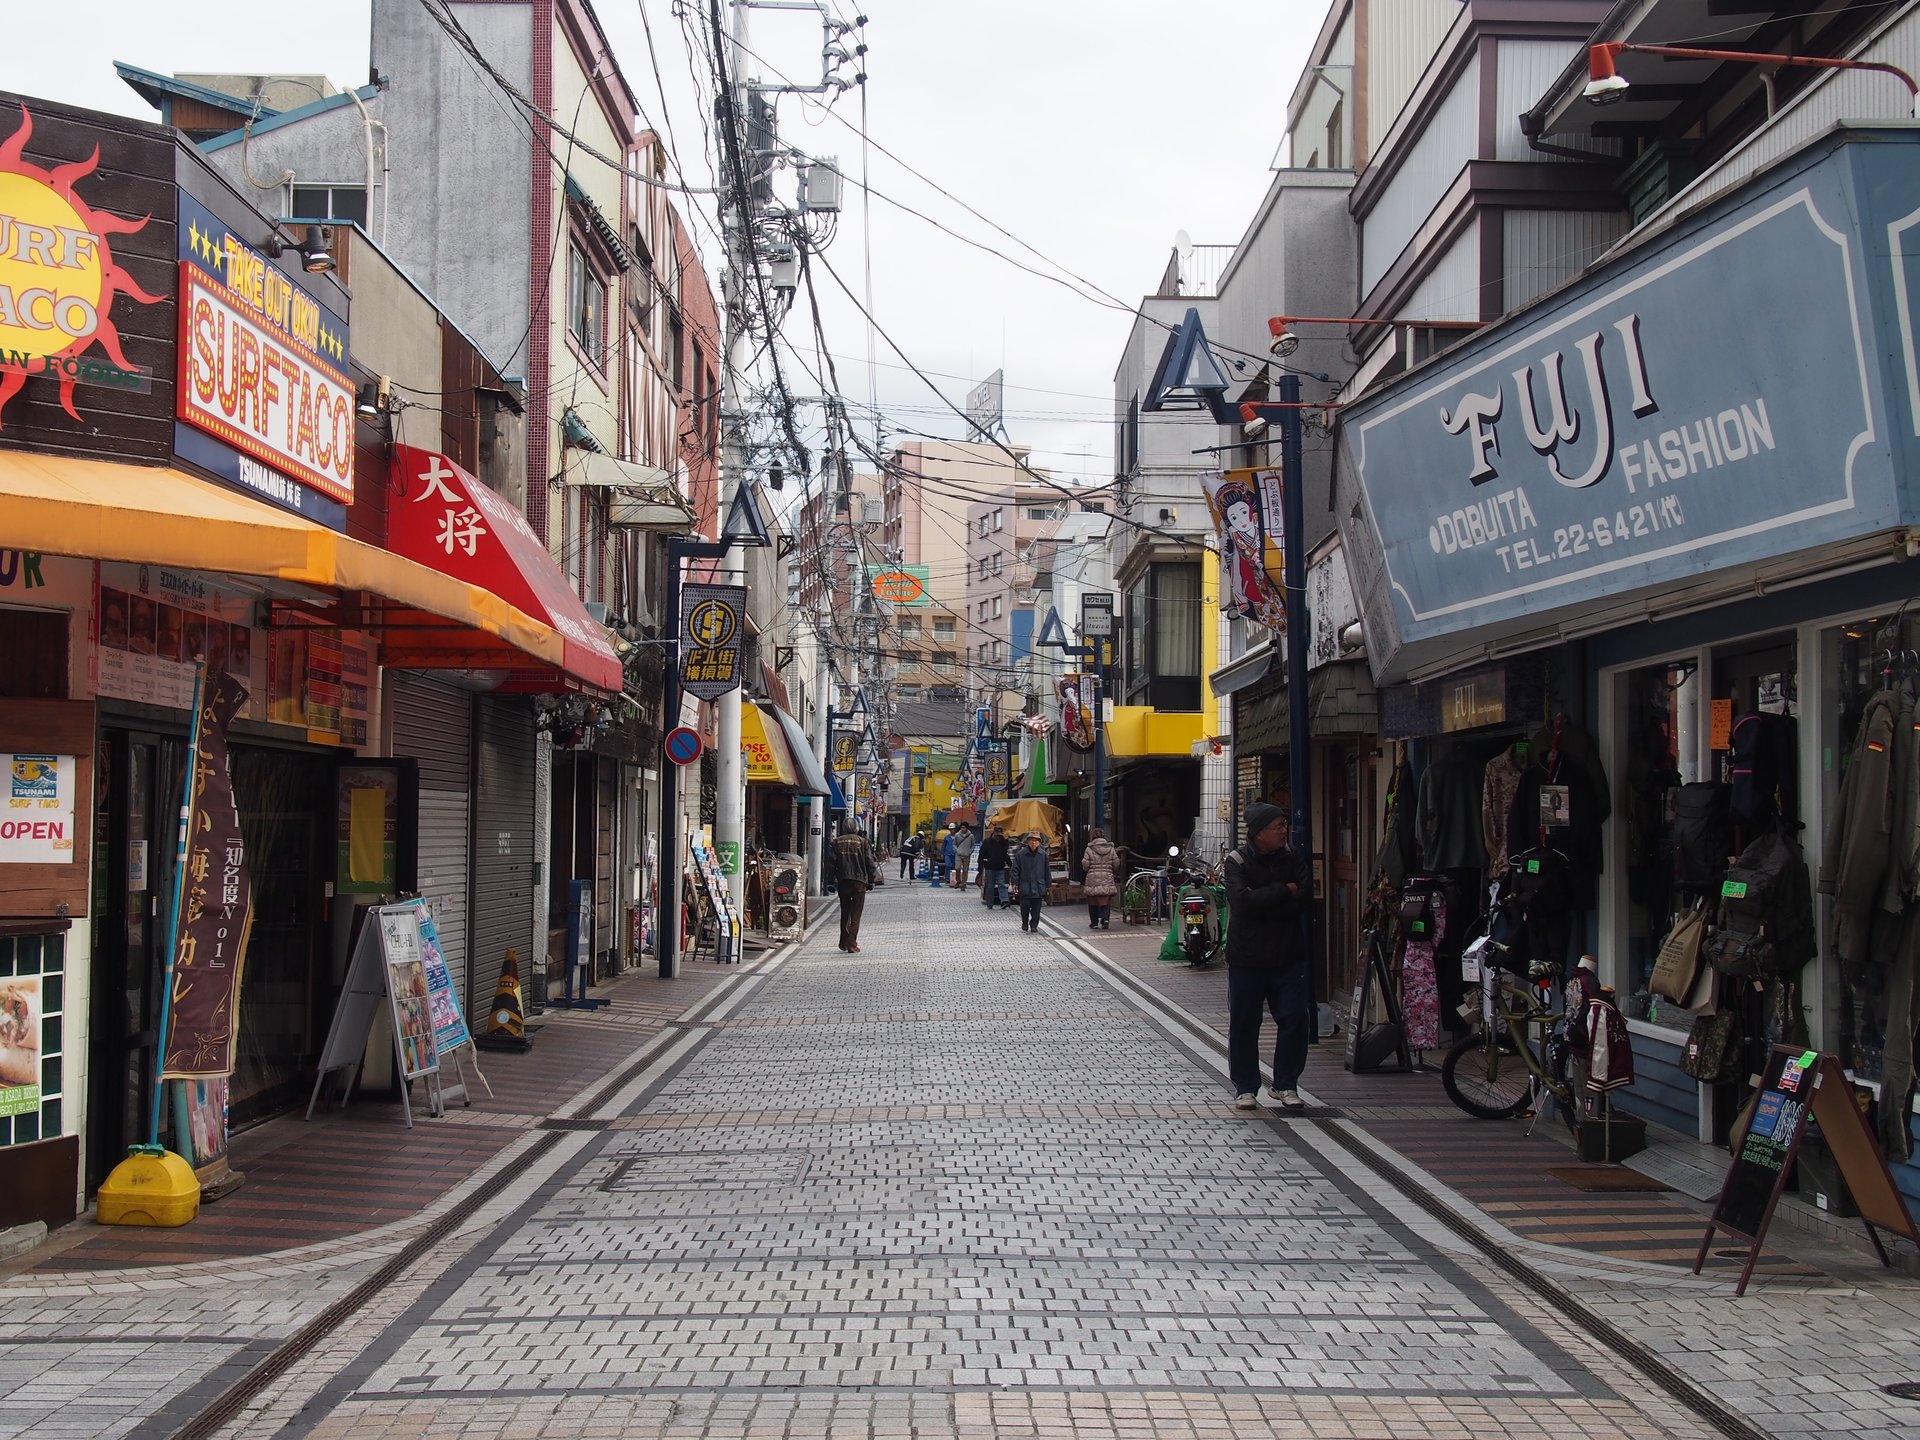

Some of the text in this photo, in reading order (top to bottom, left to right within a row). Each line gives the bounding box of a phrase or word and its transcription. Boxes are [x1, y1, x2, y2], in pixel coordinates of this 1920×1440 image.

[224, 232, 265, 313] TAKE
[264, 266, 292, 333] OUT
[42, 354, 143, 388] FOODS
[1440, 313, 1660, 488] FUJI
[1619, 397, 1776, 494] FASHION
[413, 456, 487, 557] 大将
[686, 665, 732, 680] 横須賀
[1453, 683, 1476, 724] FUJI
[741, 742, 766, 753] OSE
[755, 753, 772, 763] CO.
[9, 799, 59, 808] SURF TACO
[14, 788, 55, 796] TSUNAMI
[0, 821, 63, 839] OPEN
